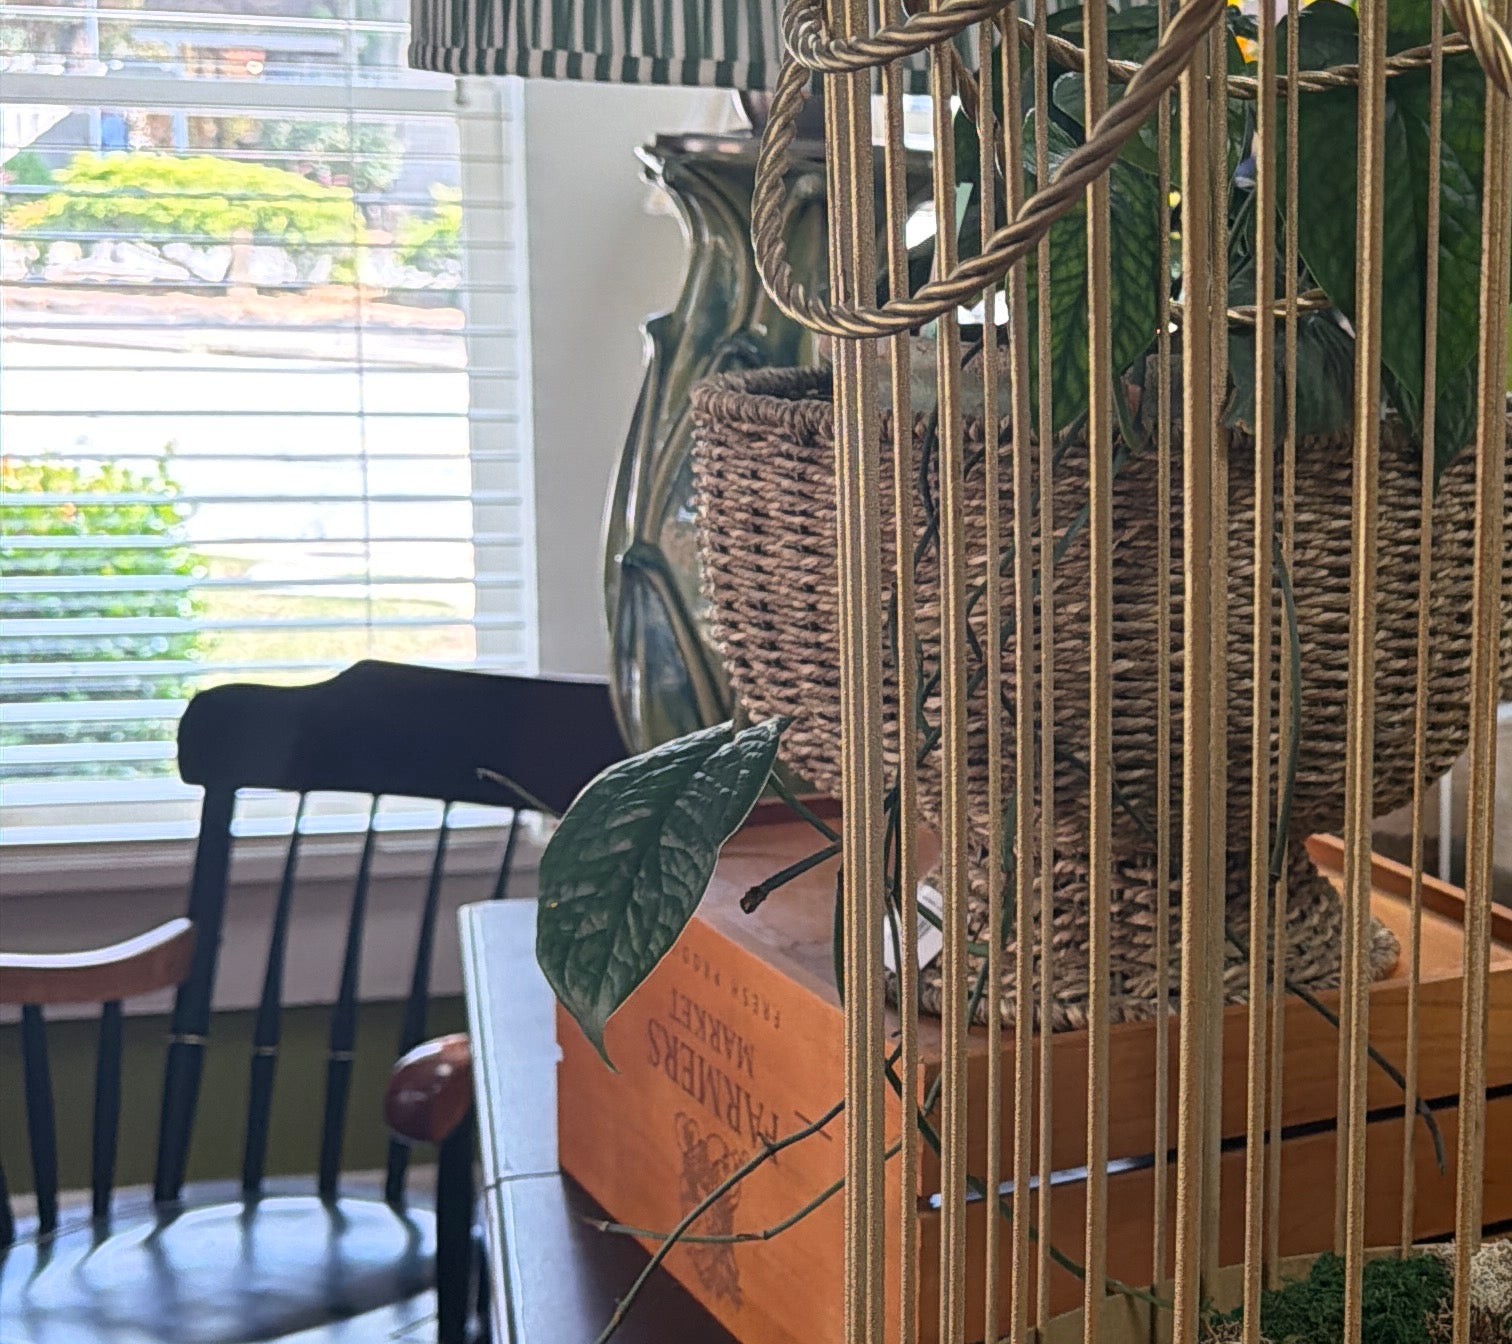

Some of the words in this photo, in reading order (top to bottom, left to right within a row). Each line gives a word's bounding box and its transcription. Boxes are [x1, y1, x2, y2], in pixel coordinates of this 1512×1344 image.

[667, 987, 754, 1079] MARKET
[729, 977, 782, 1030] FRESH
[647, 1018, 780, 1166] FARMERS
